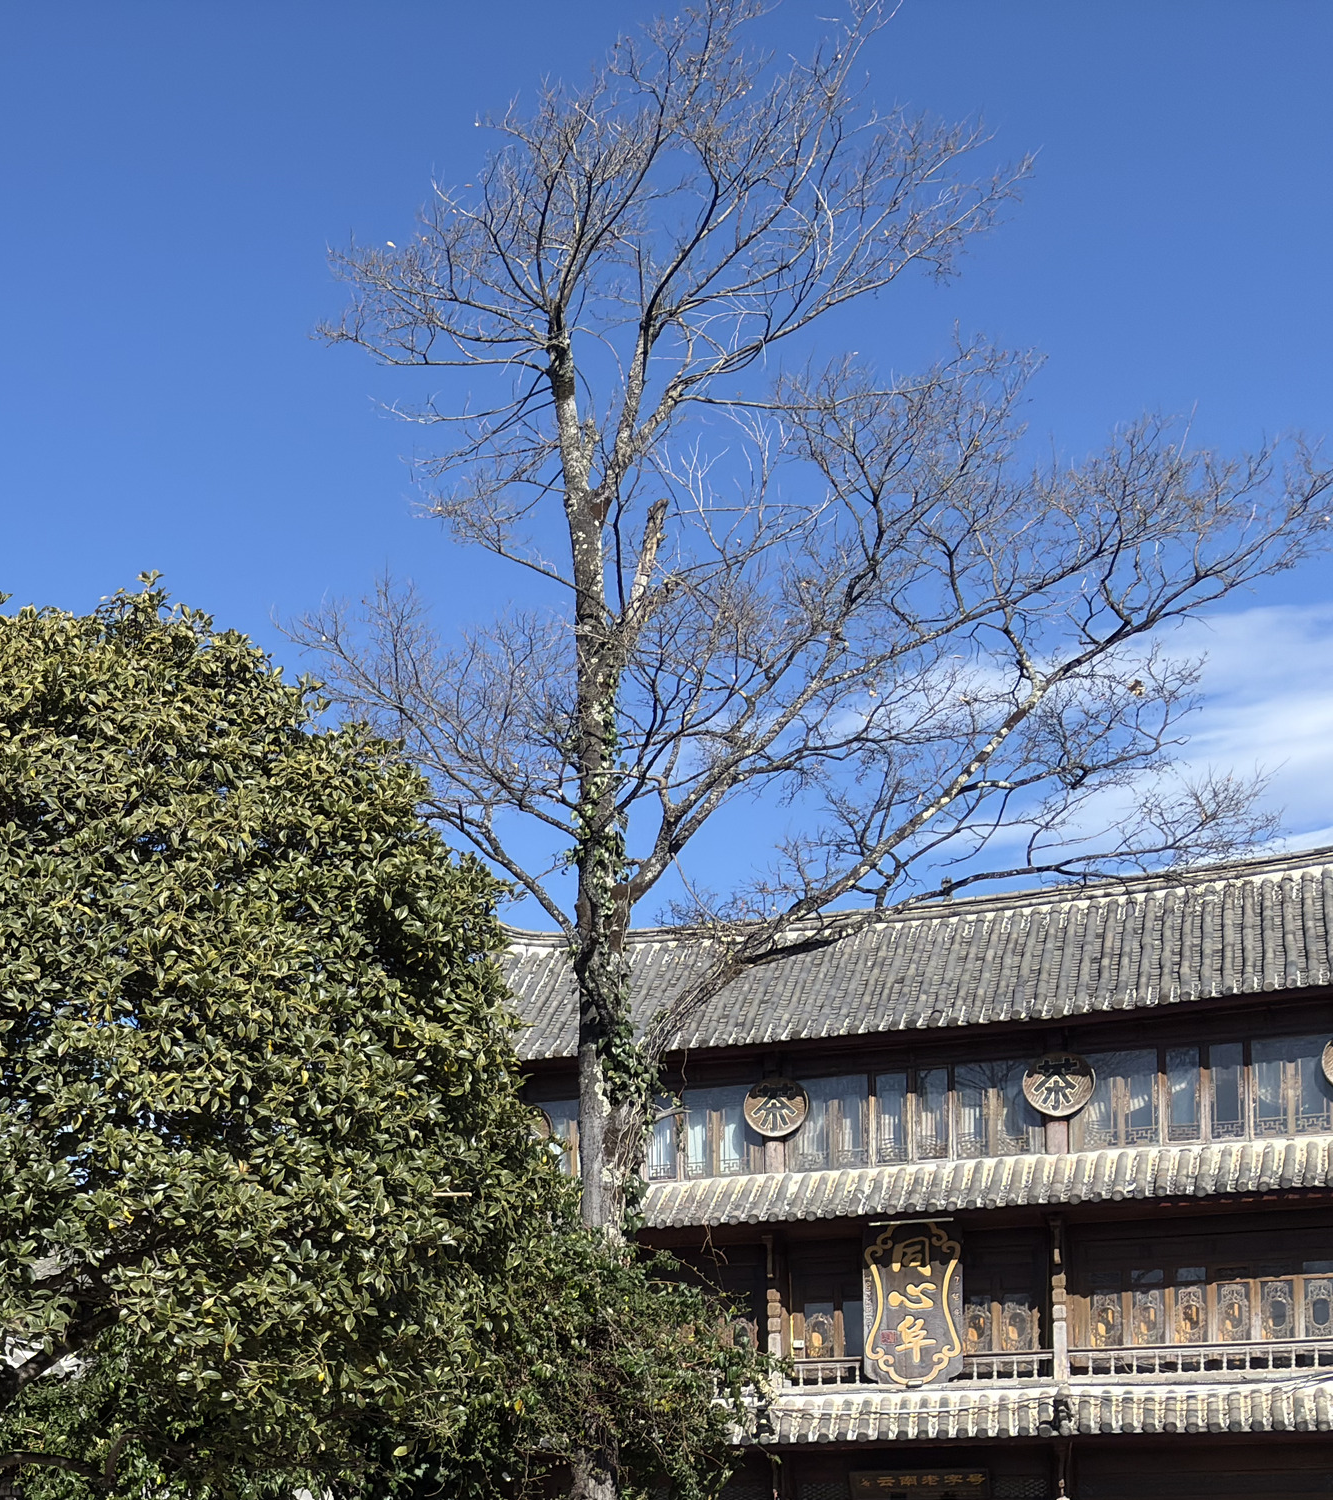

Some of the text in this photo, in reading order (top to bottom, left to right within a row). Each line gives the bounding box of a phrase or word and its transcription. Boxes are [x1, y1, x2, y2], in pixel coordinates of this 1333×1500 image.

[1031, 1057, 1079, 1112] 茶
[876, 1473, 986, 1487] 云南老字号
